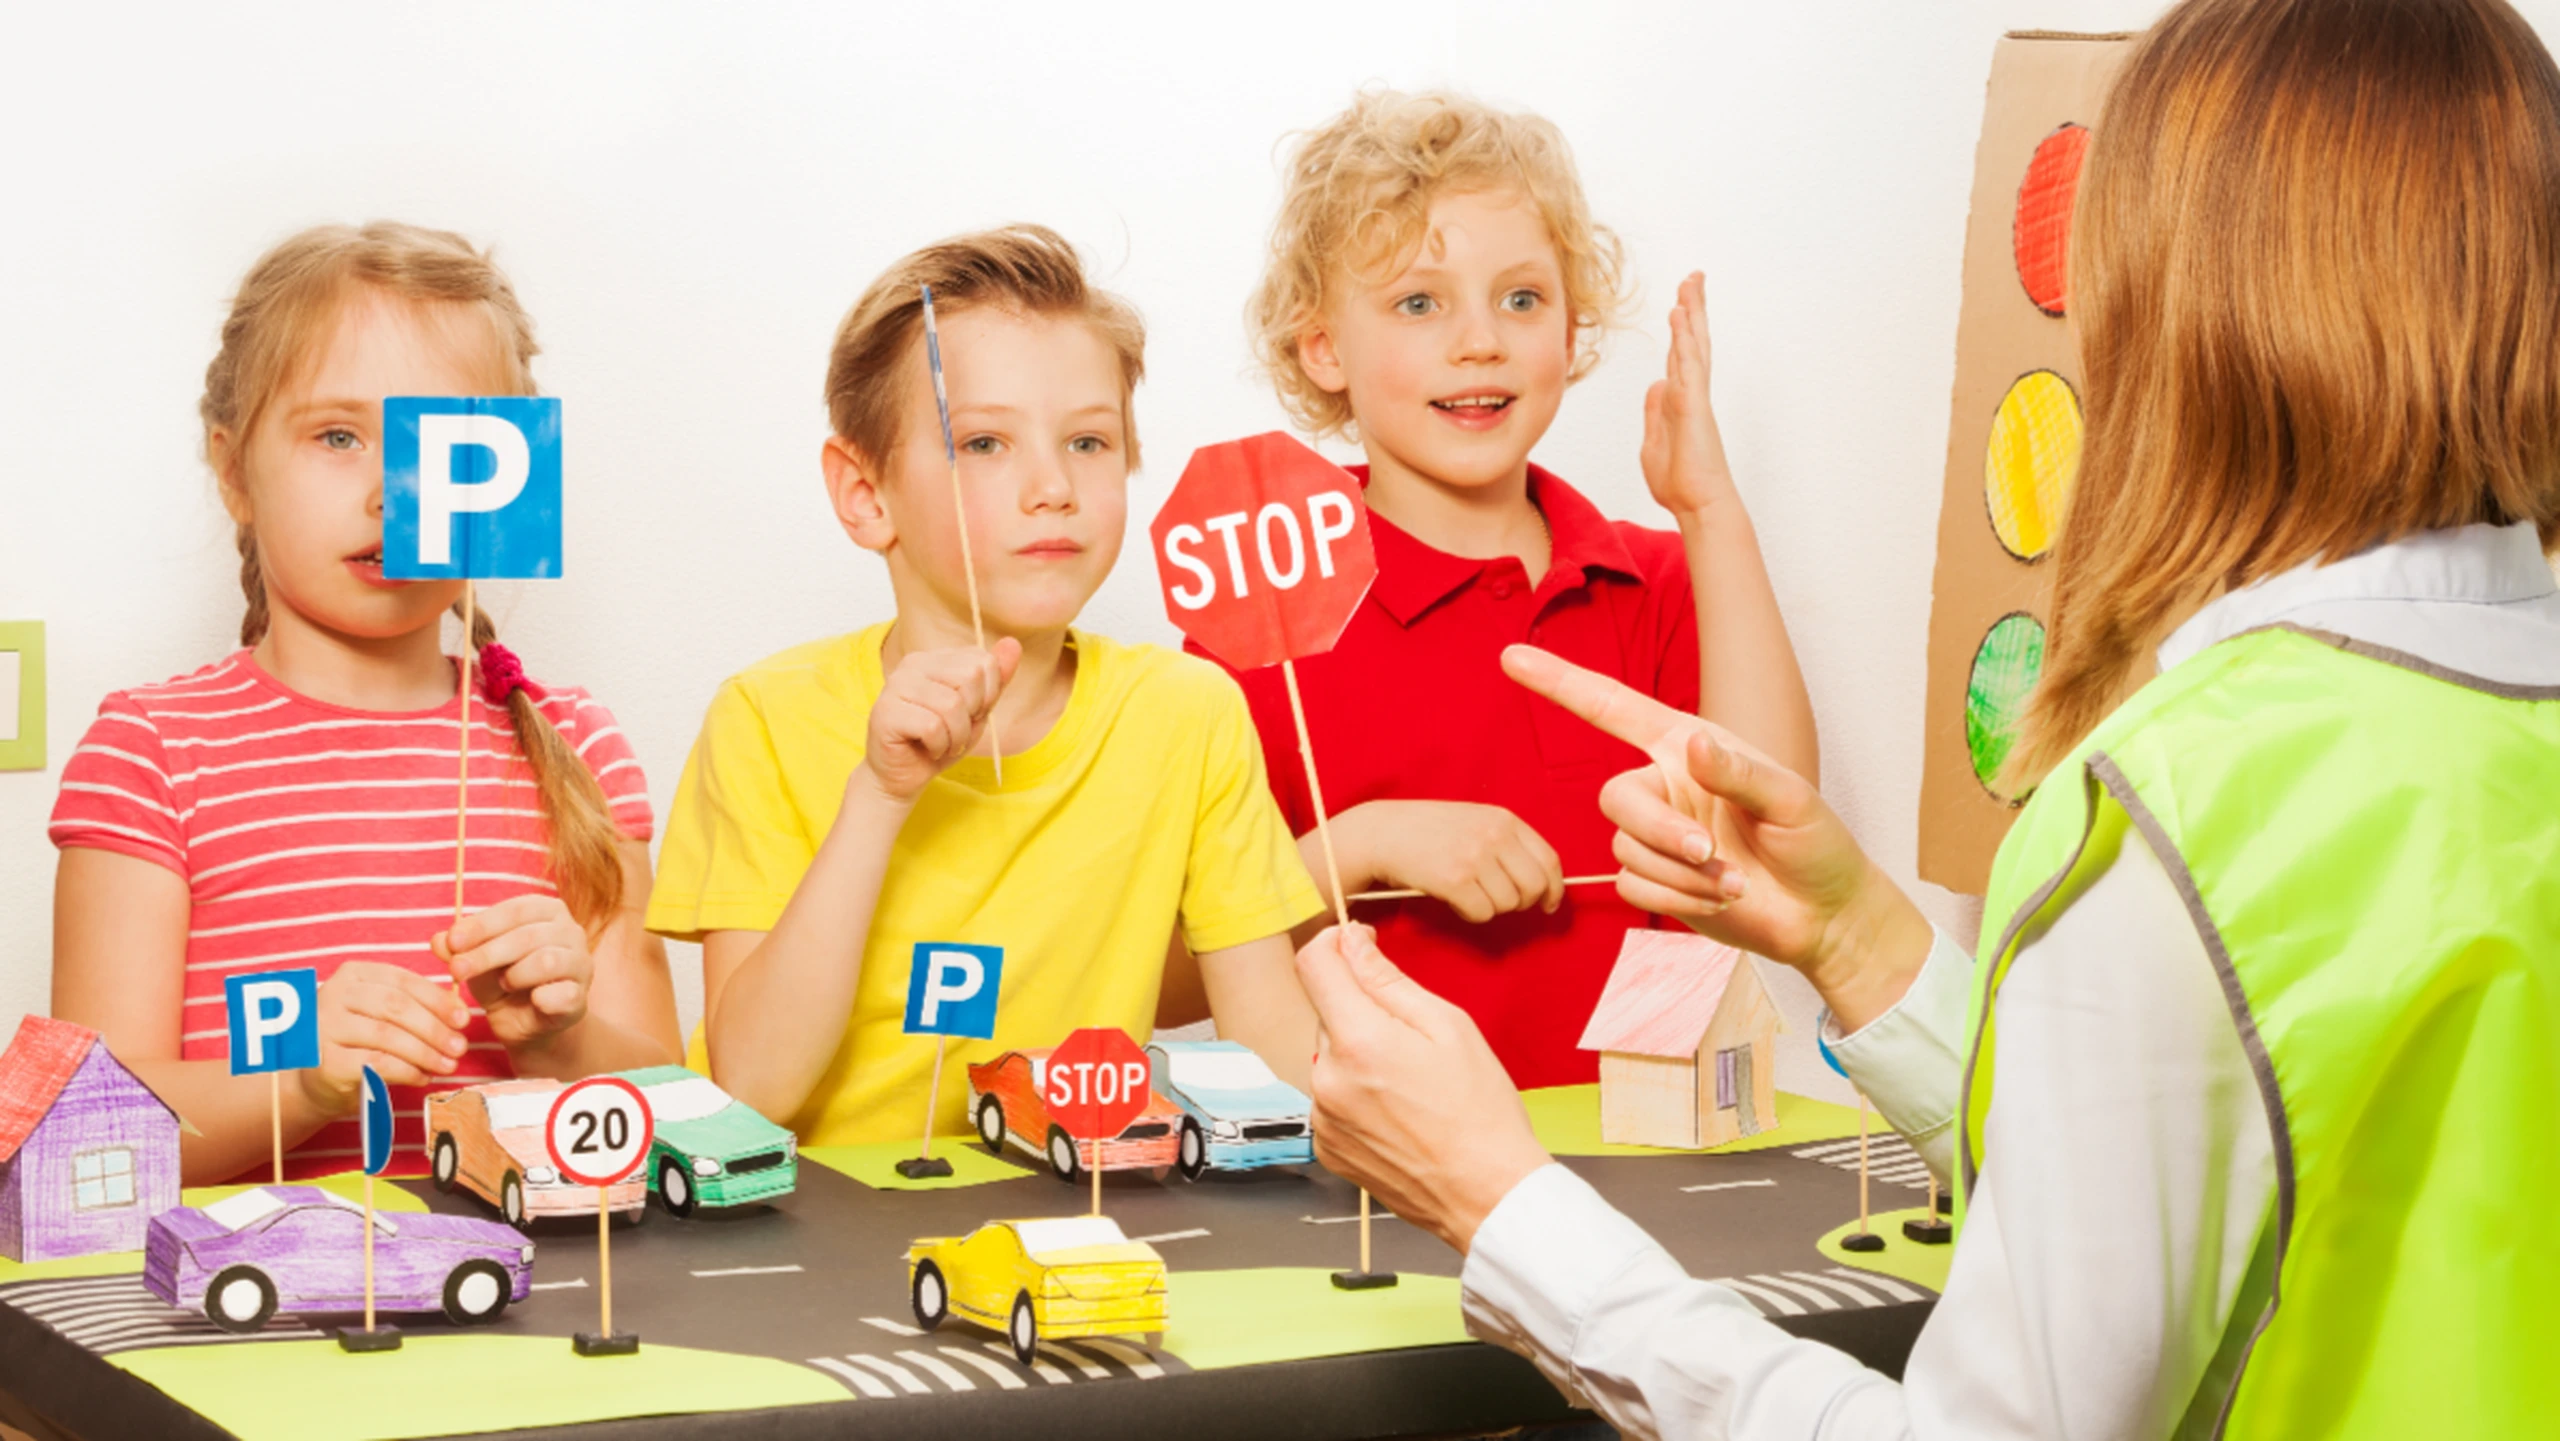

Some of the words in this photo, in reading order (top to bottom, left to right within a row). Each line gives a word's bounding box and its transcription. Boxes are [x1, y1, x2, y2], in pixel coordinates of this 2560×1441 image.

[417, 413, 531, 565] P
[1163, 490, 1356, 611] STOP
[241, 980, 302, 1066] P
[918, 950, 985, 1026] P
[1048, 1061, 1147, 1108] STOP
[569, 1106, 629, 1154] 20
